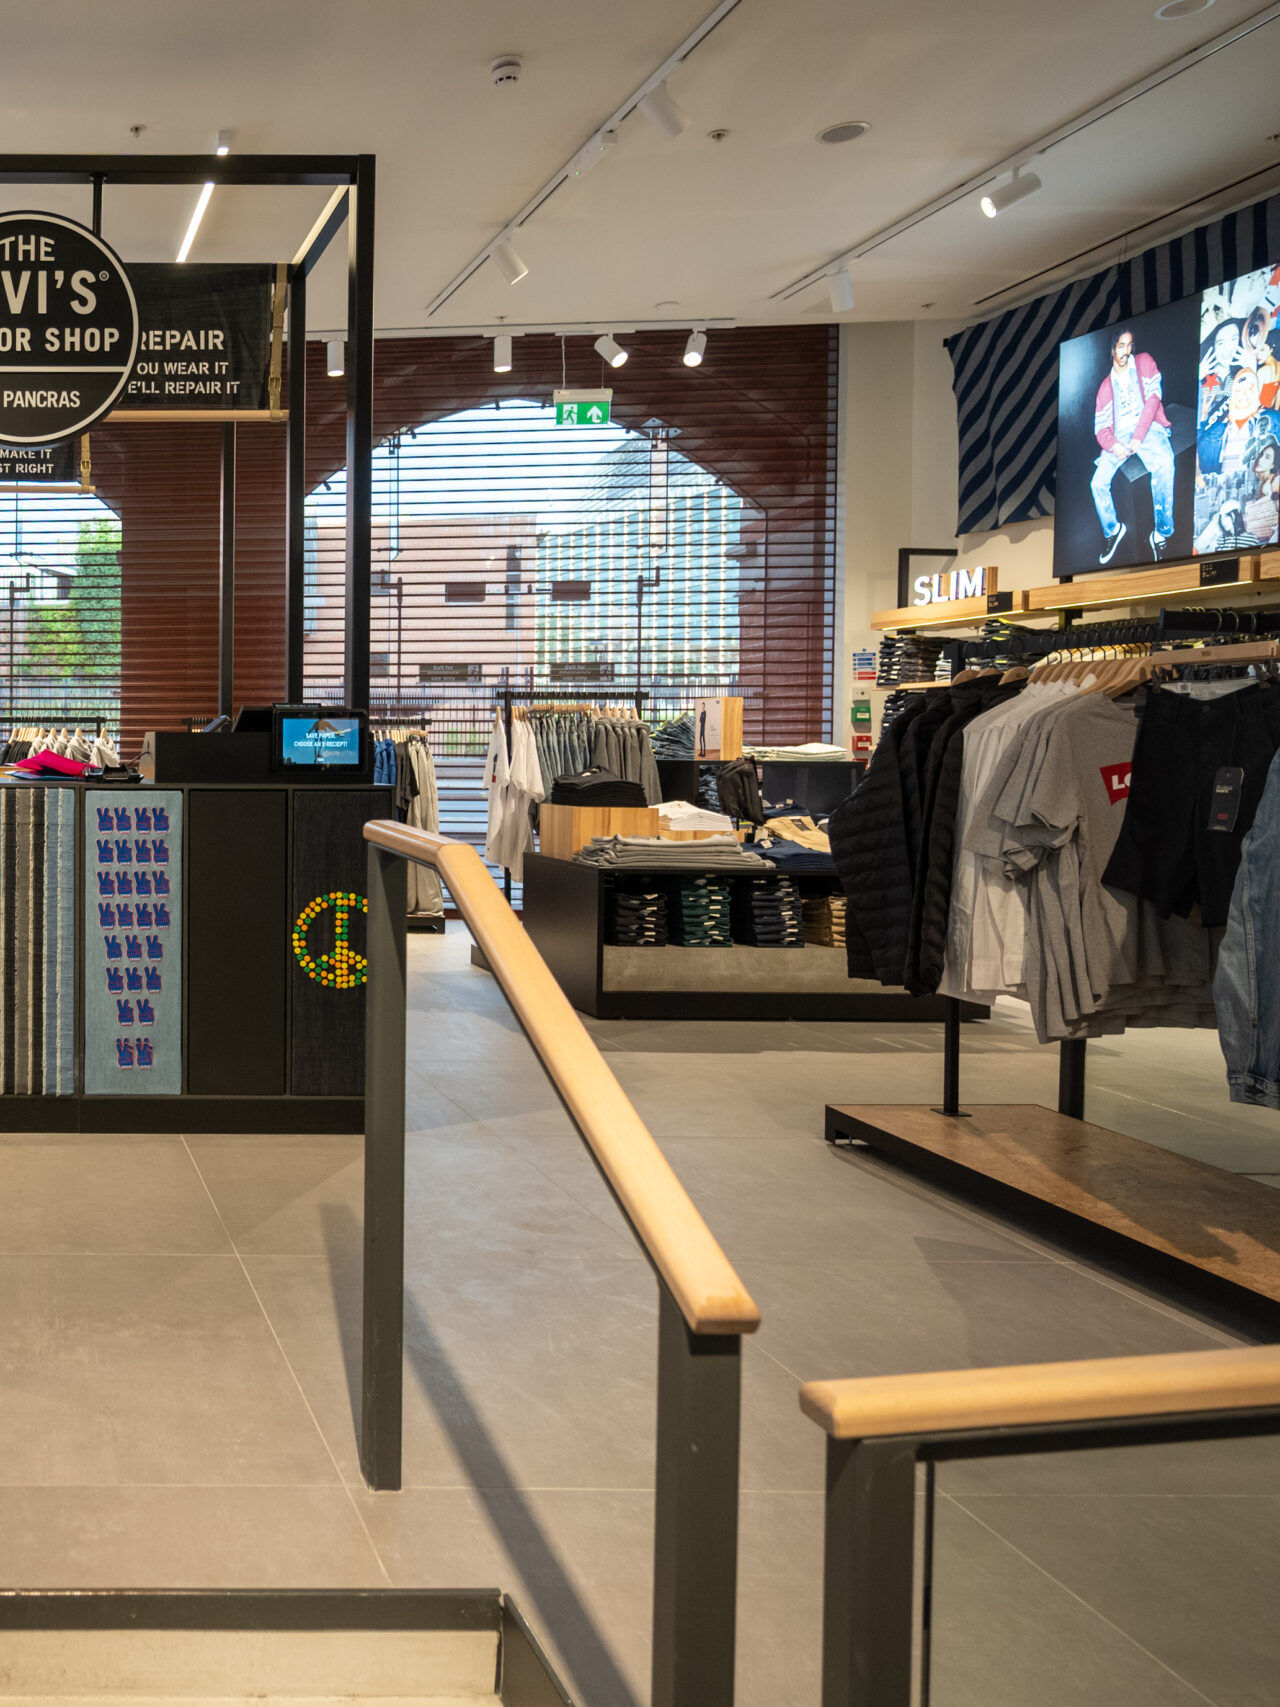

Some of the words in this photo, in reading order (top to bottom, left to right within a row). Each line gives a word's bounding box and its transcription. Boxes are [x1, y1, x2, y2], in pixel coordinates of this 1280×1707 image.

[0, 234, 55, 262] THE
[44, 327, 120, 352] SHOP
[164, 362, 210, 375] WEAR
[215, 362, 229, 375] IT
[165, 381, 222, 395] REPAIR
[226, 381, 240, 394] IT
[3, 390, 81, 408] PANCRAS
[0, 449, 36, 460] MAKE
[40, 449, 52, 459] IT
[15, 463, 54, 474] RIGHT
[913, 566, 985, 606] SLIM
